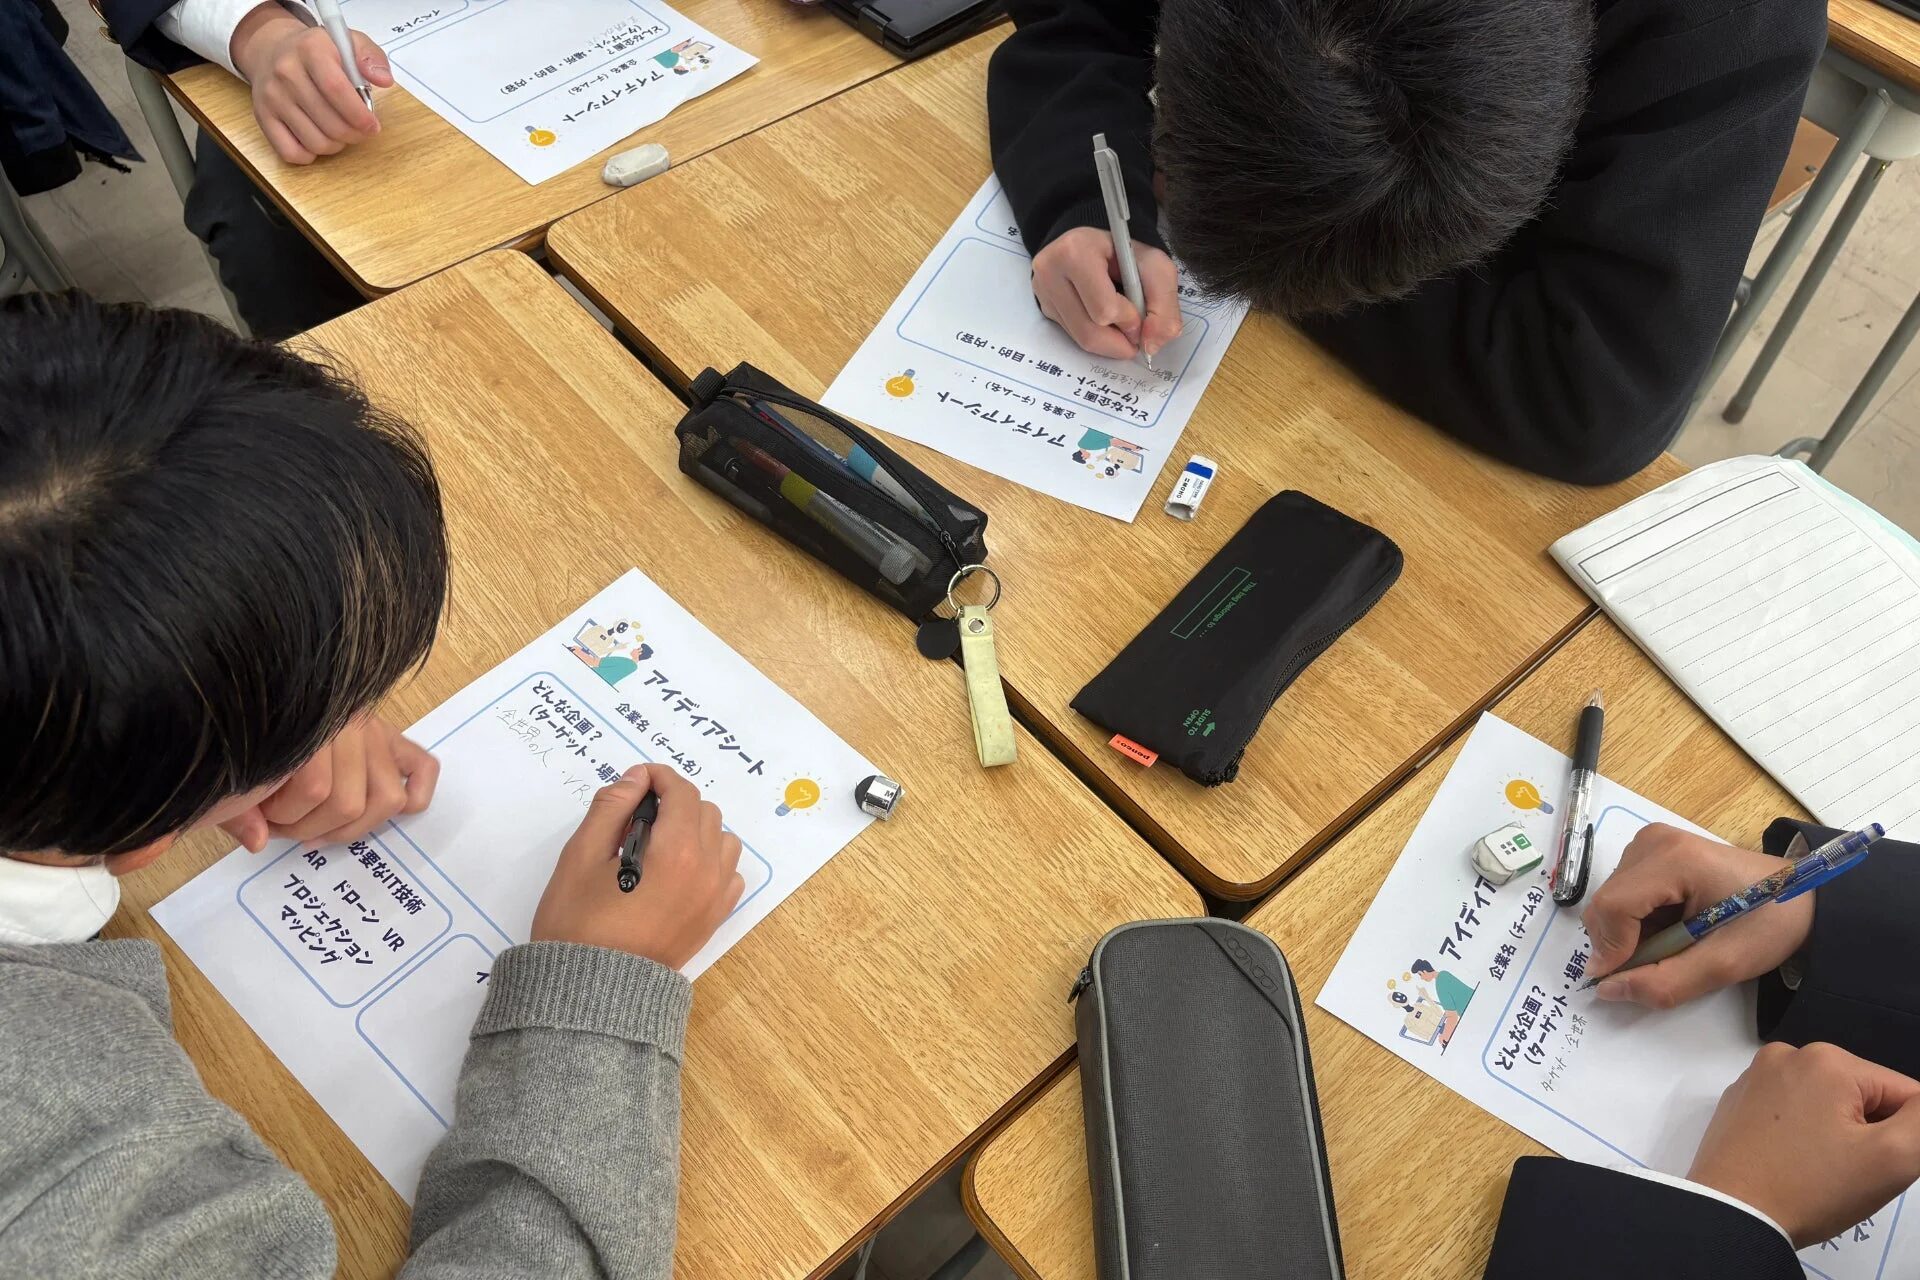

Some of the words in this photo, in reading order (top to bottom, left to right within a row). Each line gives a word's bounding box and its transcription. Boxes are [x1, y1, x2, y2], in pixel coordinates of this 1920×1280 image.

[562, 70, 665, 123] アイディアシート
[936, 391, 1067, 448] アイディアシート
[1073, 387, 1150, 422] どんな企画？
[1231, 591, 1247, 603] bag
[1243, 581, 1257, 592] This
[1213, 601, 1237, 622] belongs
[532, 680, 603, 741] どんな企画？
[643, 669, 765, 776] アイディアシート
[1182, 709, 1200, 727] OPEN
[1195, 708, 1211, 727] SLIDE
[1187, 726, 1198, 736] TO
[302, 849, 328, 871] AR
[347, 840, 427, 916] 必要なIT技術
[284, 873, 374, 965] プロジェクション
[333, 880, 380, 923] ドローン
[281, 905, 343, 964] マッピング
[382, 926, 405, 953] VR
[1494, 985, 1546, 1072] どんな企画？
